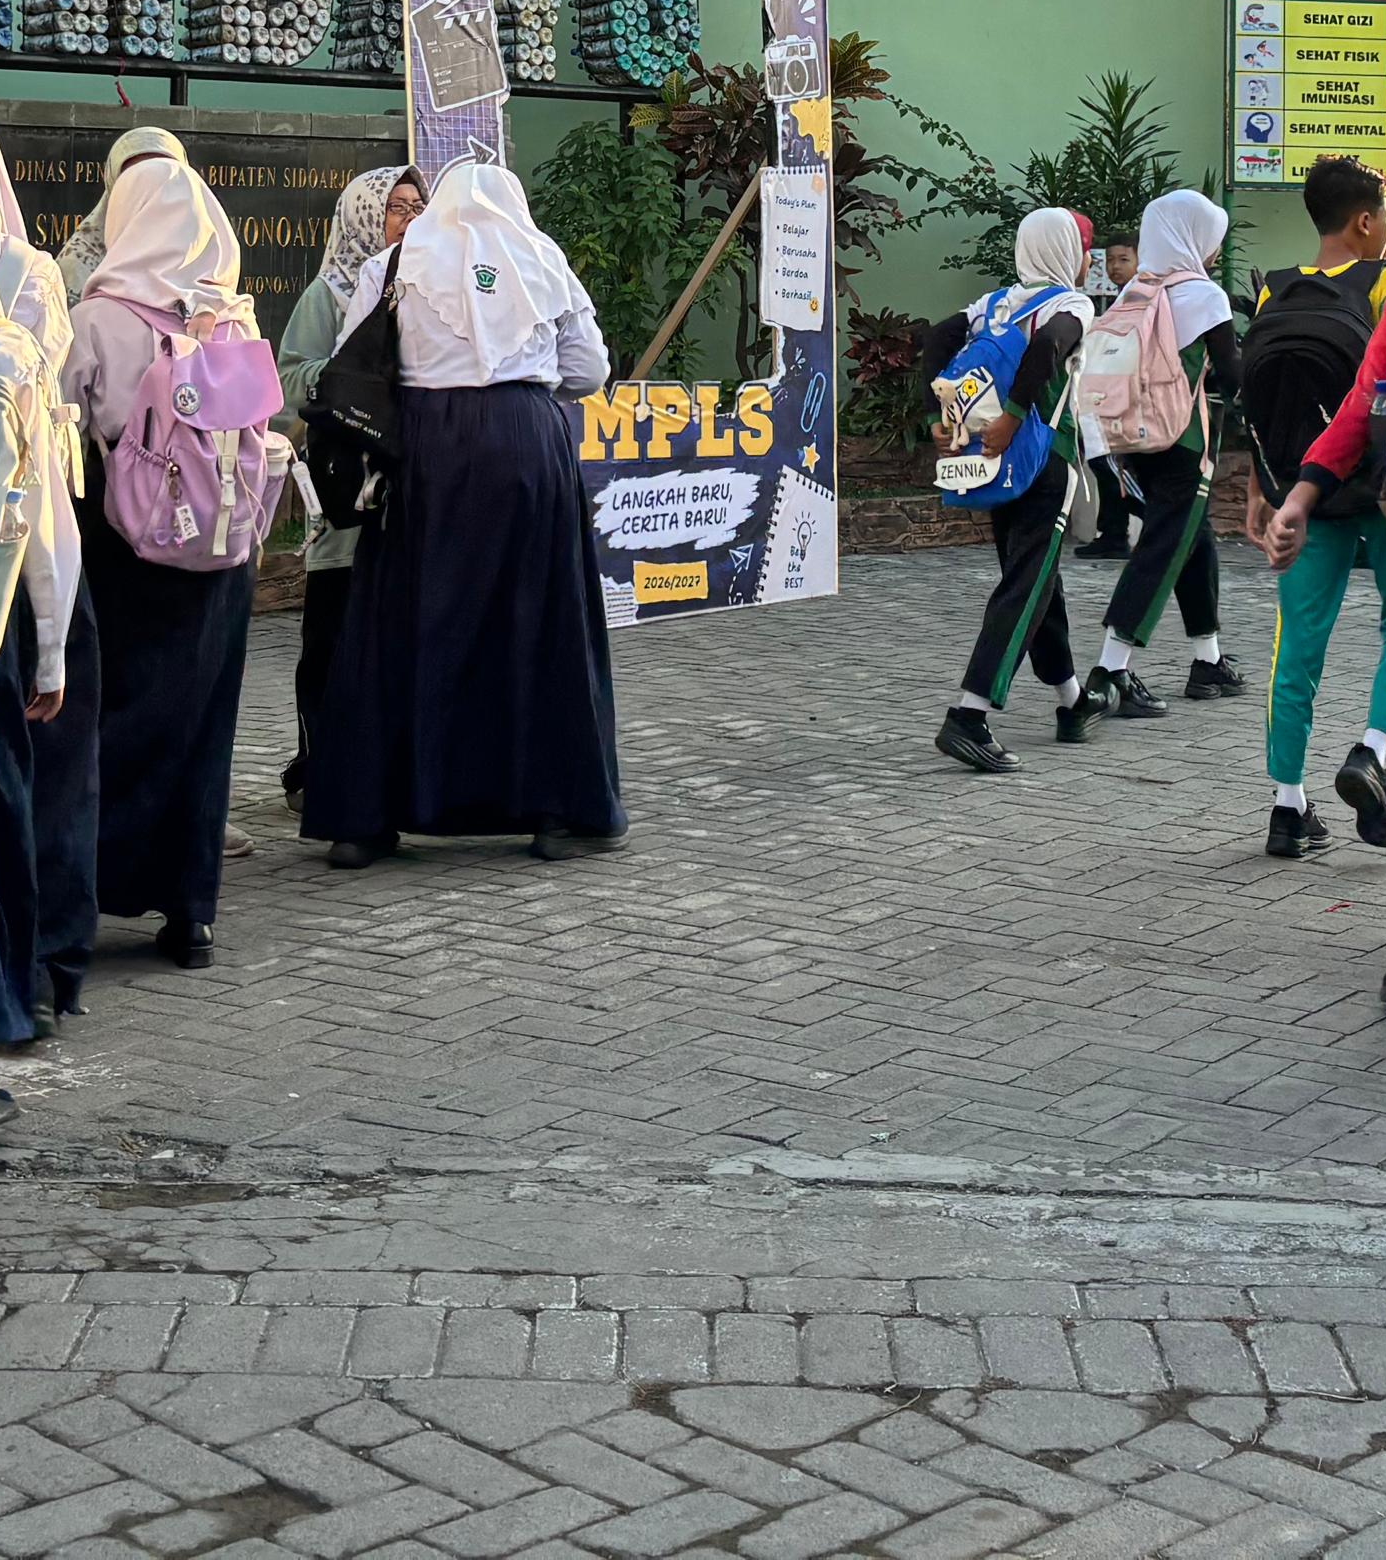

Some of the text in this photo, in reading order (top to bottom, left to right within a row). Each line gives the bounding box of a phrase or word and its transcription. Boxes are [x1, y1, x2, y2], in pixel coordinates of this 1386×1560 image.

[1303, 14, 1373, 26] SEHAT GIZI
[1296, 50, 1379, 62] SEHAT FISIK
[1316, 81, 1360, 92] SEHAT
[1302, 94, 1375, 105] IMUNISASI
[1289, 123, 1386, 136] SEHAT MENTAL
[15, 159, 67, 183] DINAS
[782, 223, 809, 239] Belajar
[782, 245, 817, 258] Berusaha
[781, 267, 809, 279] Berdoa
[781, 288, 812, 301] Berhasil
[579, 384, 774, 461] MPLS
[941, 462, 988, 480] ZENNIA
[613, 482, 733, 511] LANGKAH BARU,
[621, 507, 727, 535] CERITA BARU!
[644, 575, 701, 591] 2026/2027
[784, 577, 804, 589] BEST
